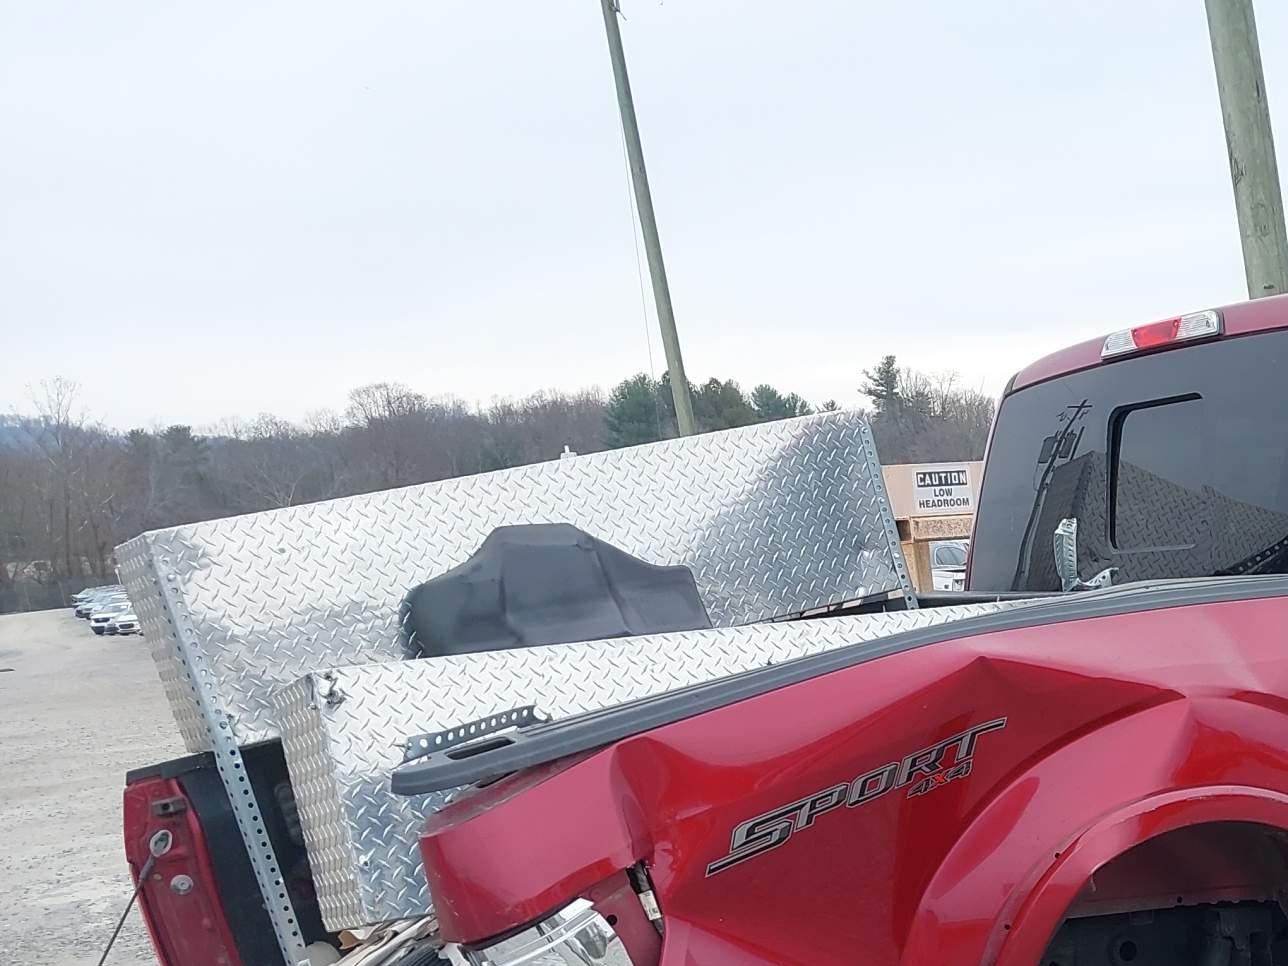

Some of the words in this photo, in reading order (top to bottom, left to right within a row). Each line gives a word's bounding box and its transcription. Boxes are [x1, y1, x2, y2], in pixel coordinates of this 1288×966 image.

[917, 471, 967, 486] CAUTION
[933, 488, 953, 497] LOW
[918, 498, 970, 509] HEADROOM
[705, 717, 1007, 878] SPORT
